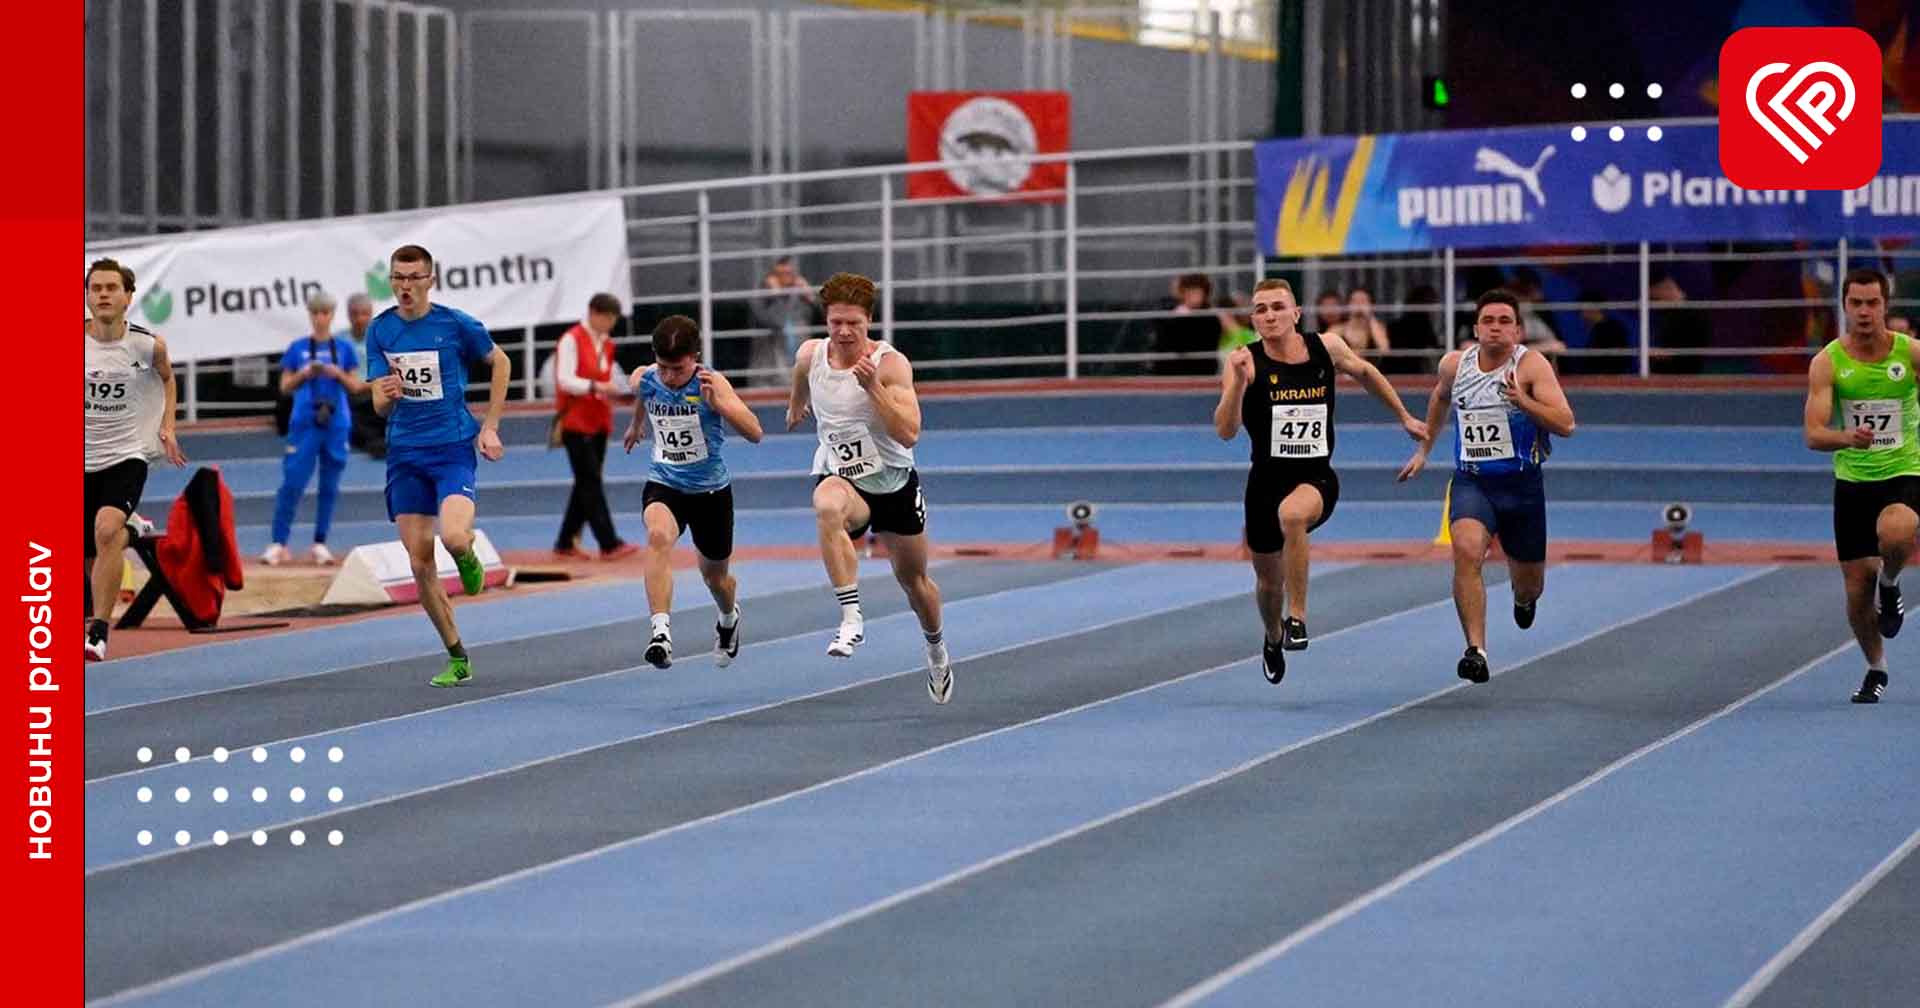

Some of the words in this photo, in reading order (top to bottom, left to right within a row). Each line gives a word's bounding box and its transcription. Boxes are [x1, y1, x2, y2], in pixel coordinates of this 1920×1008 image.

[1398, 183, 1523, 227] PUMA
[89, 383, 126, 399] 195
[658, 430, 694, 448] 145
[1280, 421, 1321, 440] 478
[1464, 425, 1501, 443] 412
[1280, 443, 1312, 456] PUMA
